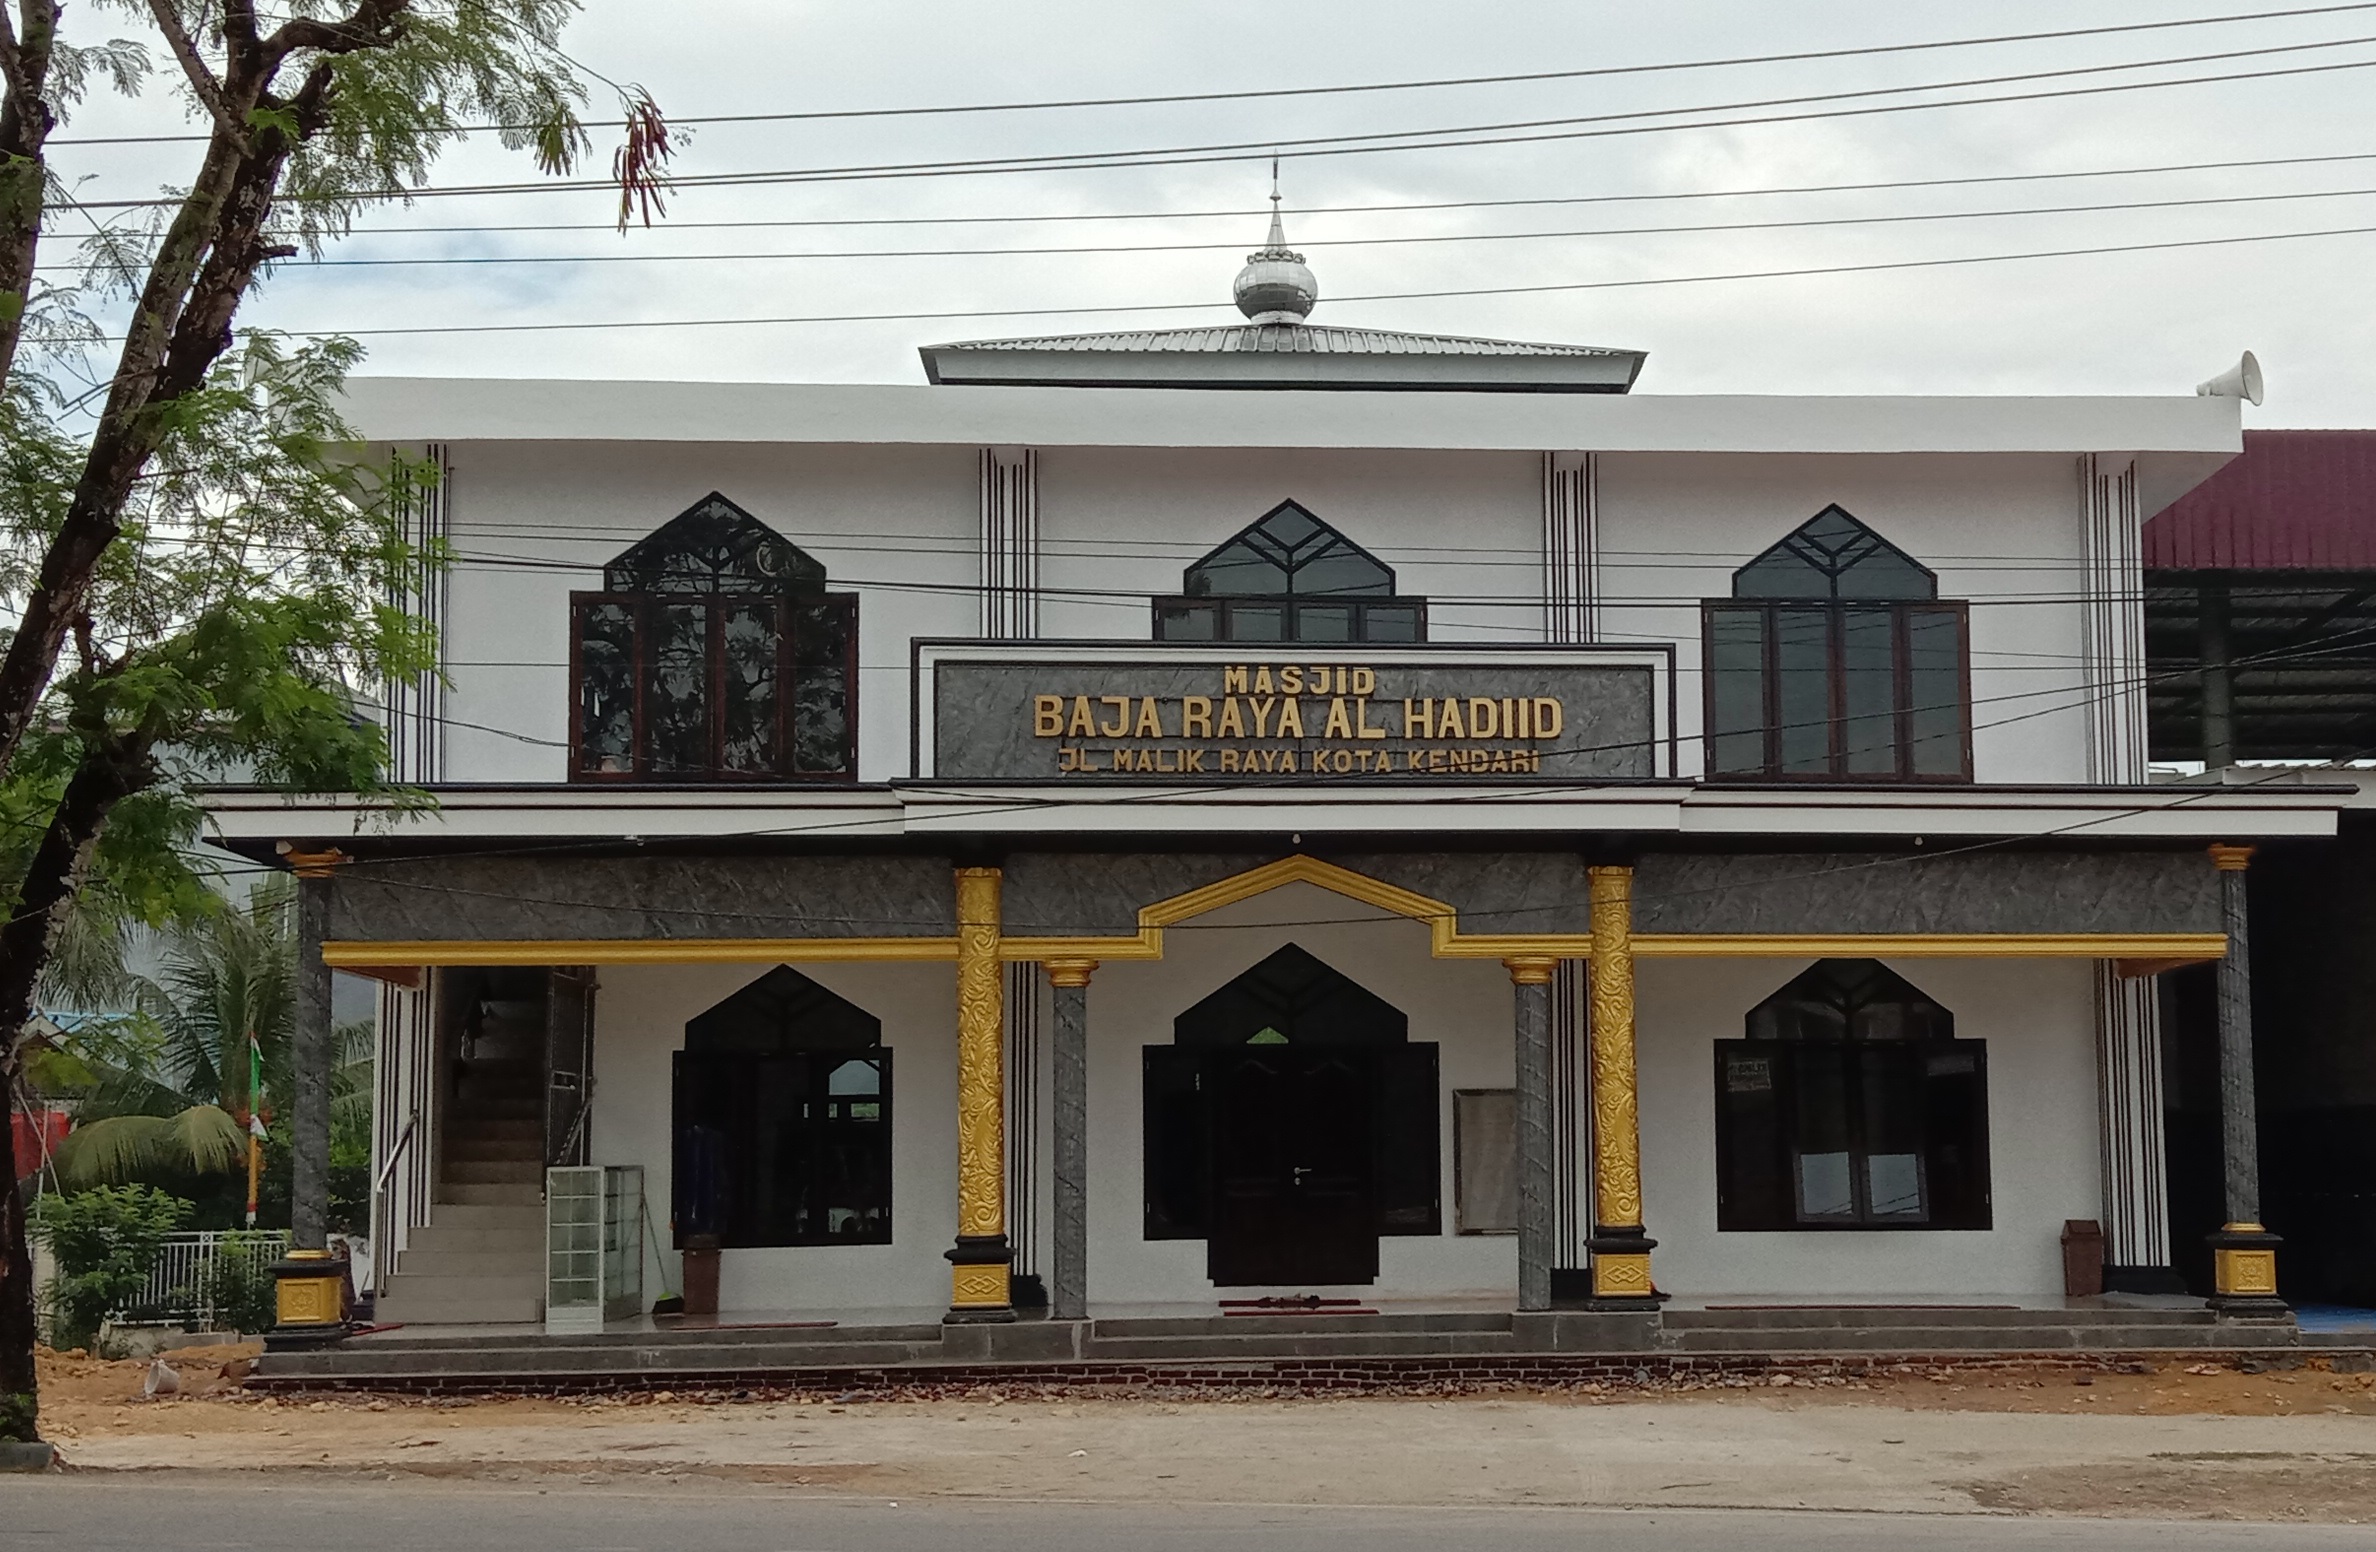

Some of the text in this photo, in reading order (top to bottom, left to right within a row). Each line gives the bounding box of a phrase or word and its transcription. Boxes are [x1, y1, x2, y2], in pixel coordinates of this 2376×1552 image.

[1224, 666, 1375, 695] MASJID
[1033, 695, 1563, 739] BAJA RAYA AL HADIID
[1059, 747, 1540, 773] JL MALIK RAYA KOTA KENDARI
